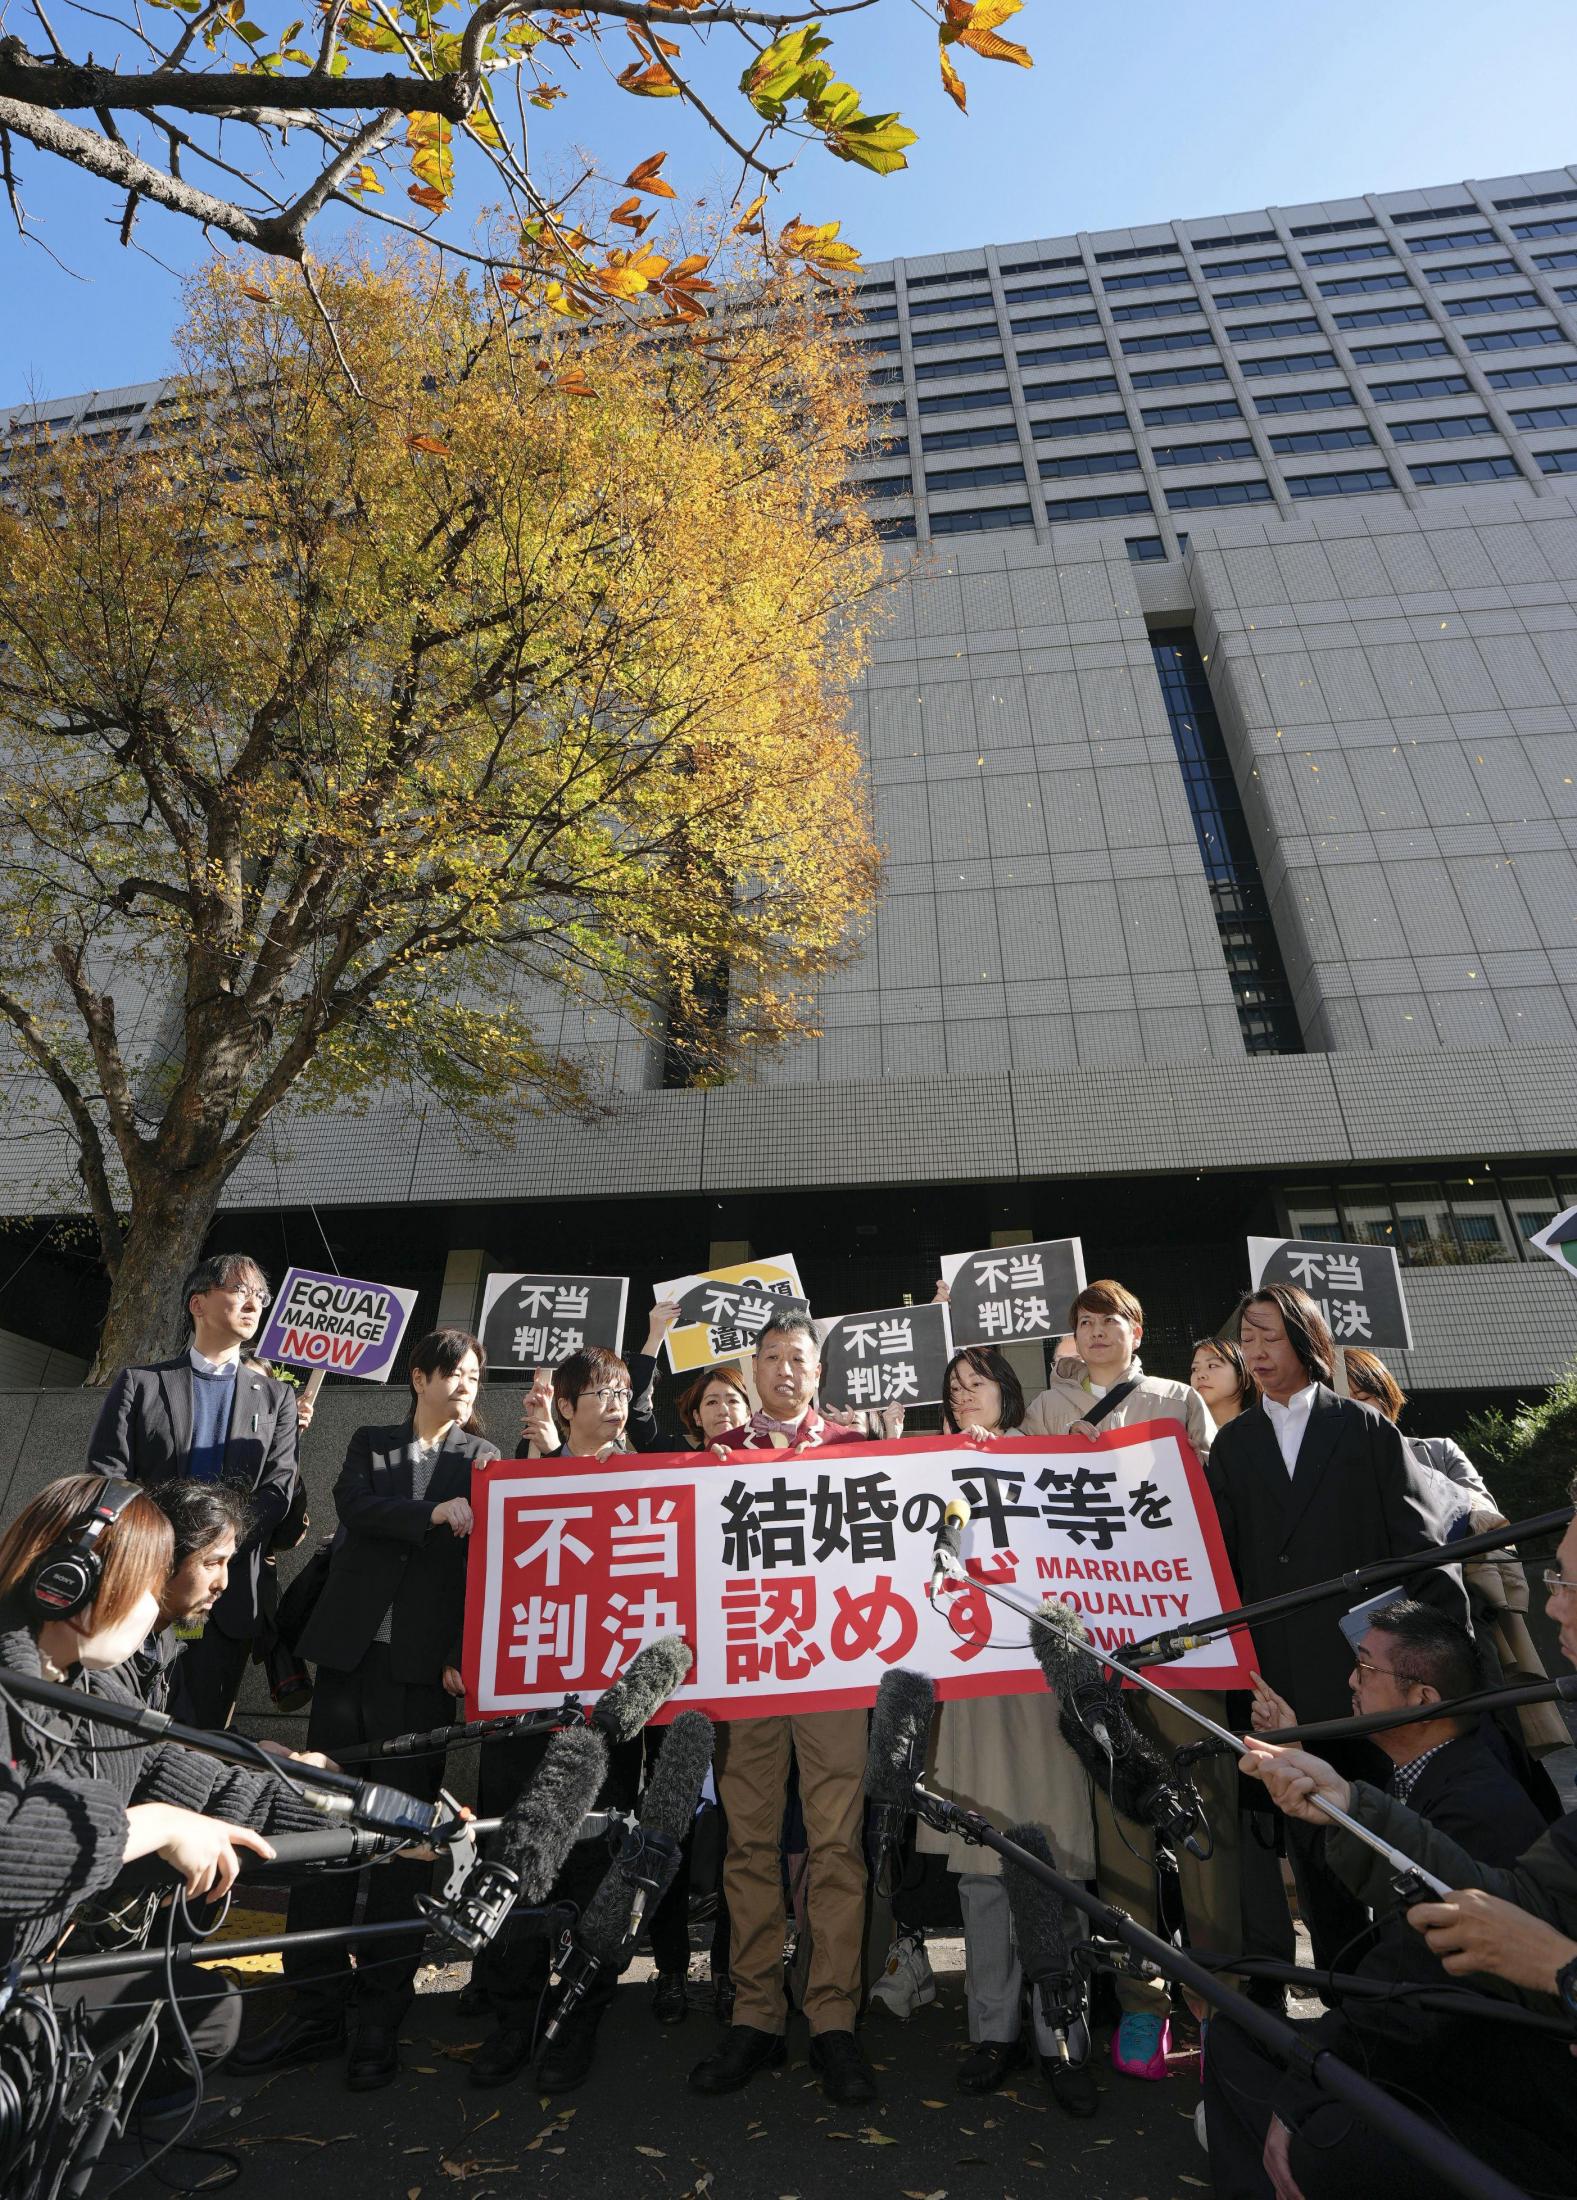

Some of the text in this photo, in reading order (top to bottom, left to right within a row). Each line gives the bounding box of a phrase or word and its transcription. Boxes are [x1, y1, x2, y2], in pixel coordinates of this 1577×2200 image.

[974, 1253, 1045, 1293] 不当
[1286, 1251, 1364, 1291] 不当
[290, 1281, 388, 1321] EQUAL
[518, 1285, 590, 1319] 不当
[701, 1289, 775, 1332] 不当
[978, 1296, 1050, 1337] 判決
[281, 1307, 384, 1342] MARRIAGE
[511, 1326, 585, 1362] 判決
[843, 1317, 914, 1359] 不当
[282, 1329, 365, 1366] NOW
[846, 1361, 920, 1404] 判決
[720, 1466, 1174, 1572] 結婚の平等を
[513, 1498, 679, 1586] 不当
[1036, 1556, 1193, 1583] MARRIAGE
[508, 1588, 687, 1685] 判決
[721, 1549, 1020, 1685] 認めず
